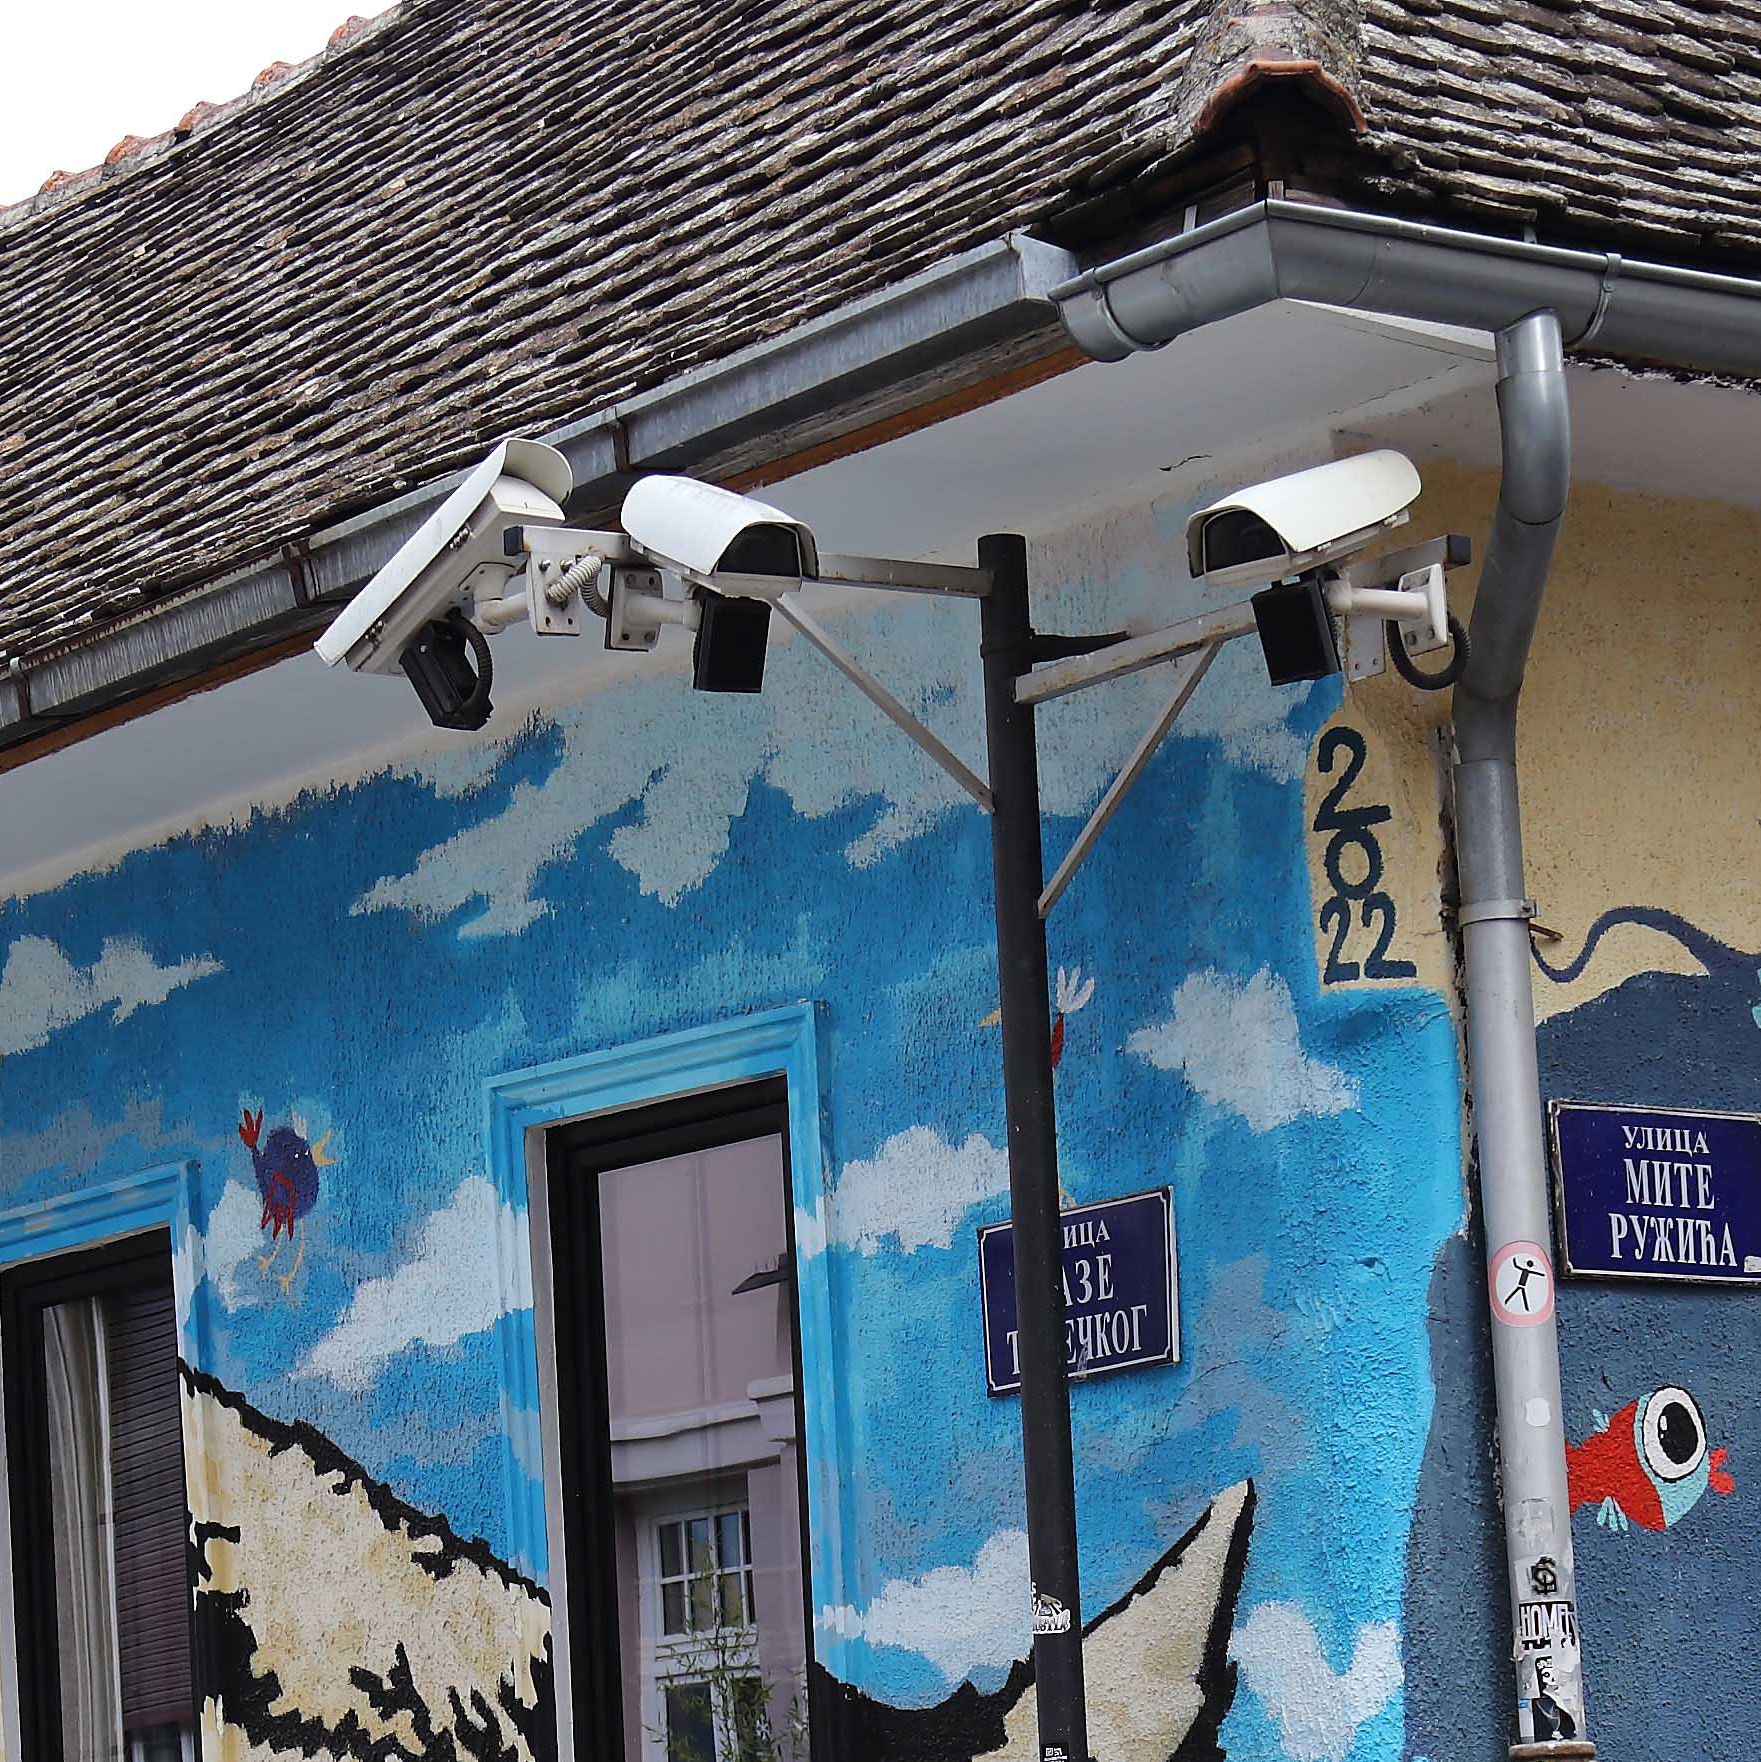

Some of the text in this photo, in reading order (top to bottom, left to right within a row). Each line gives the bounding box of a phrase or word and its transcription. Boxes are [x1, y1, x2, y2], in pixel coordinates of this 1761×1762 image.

[1622, 1125, 1710, 1156] УЛИЦА
[1623, 1158, 1715, 1210] МИТЕ
[1062, 1219, 1111, 1249] ИЦА
[1608, 1212, 1737, 1267] РУЖИЋА
[1006, 1304, 1147, 1375] ТЕЧКОГ
